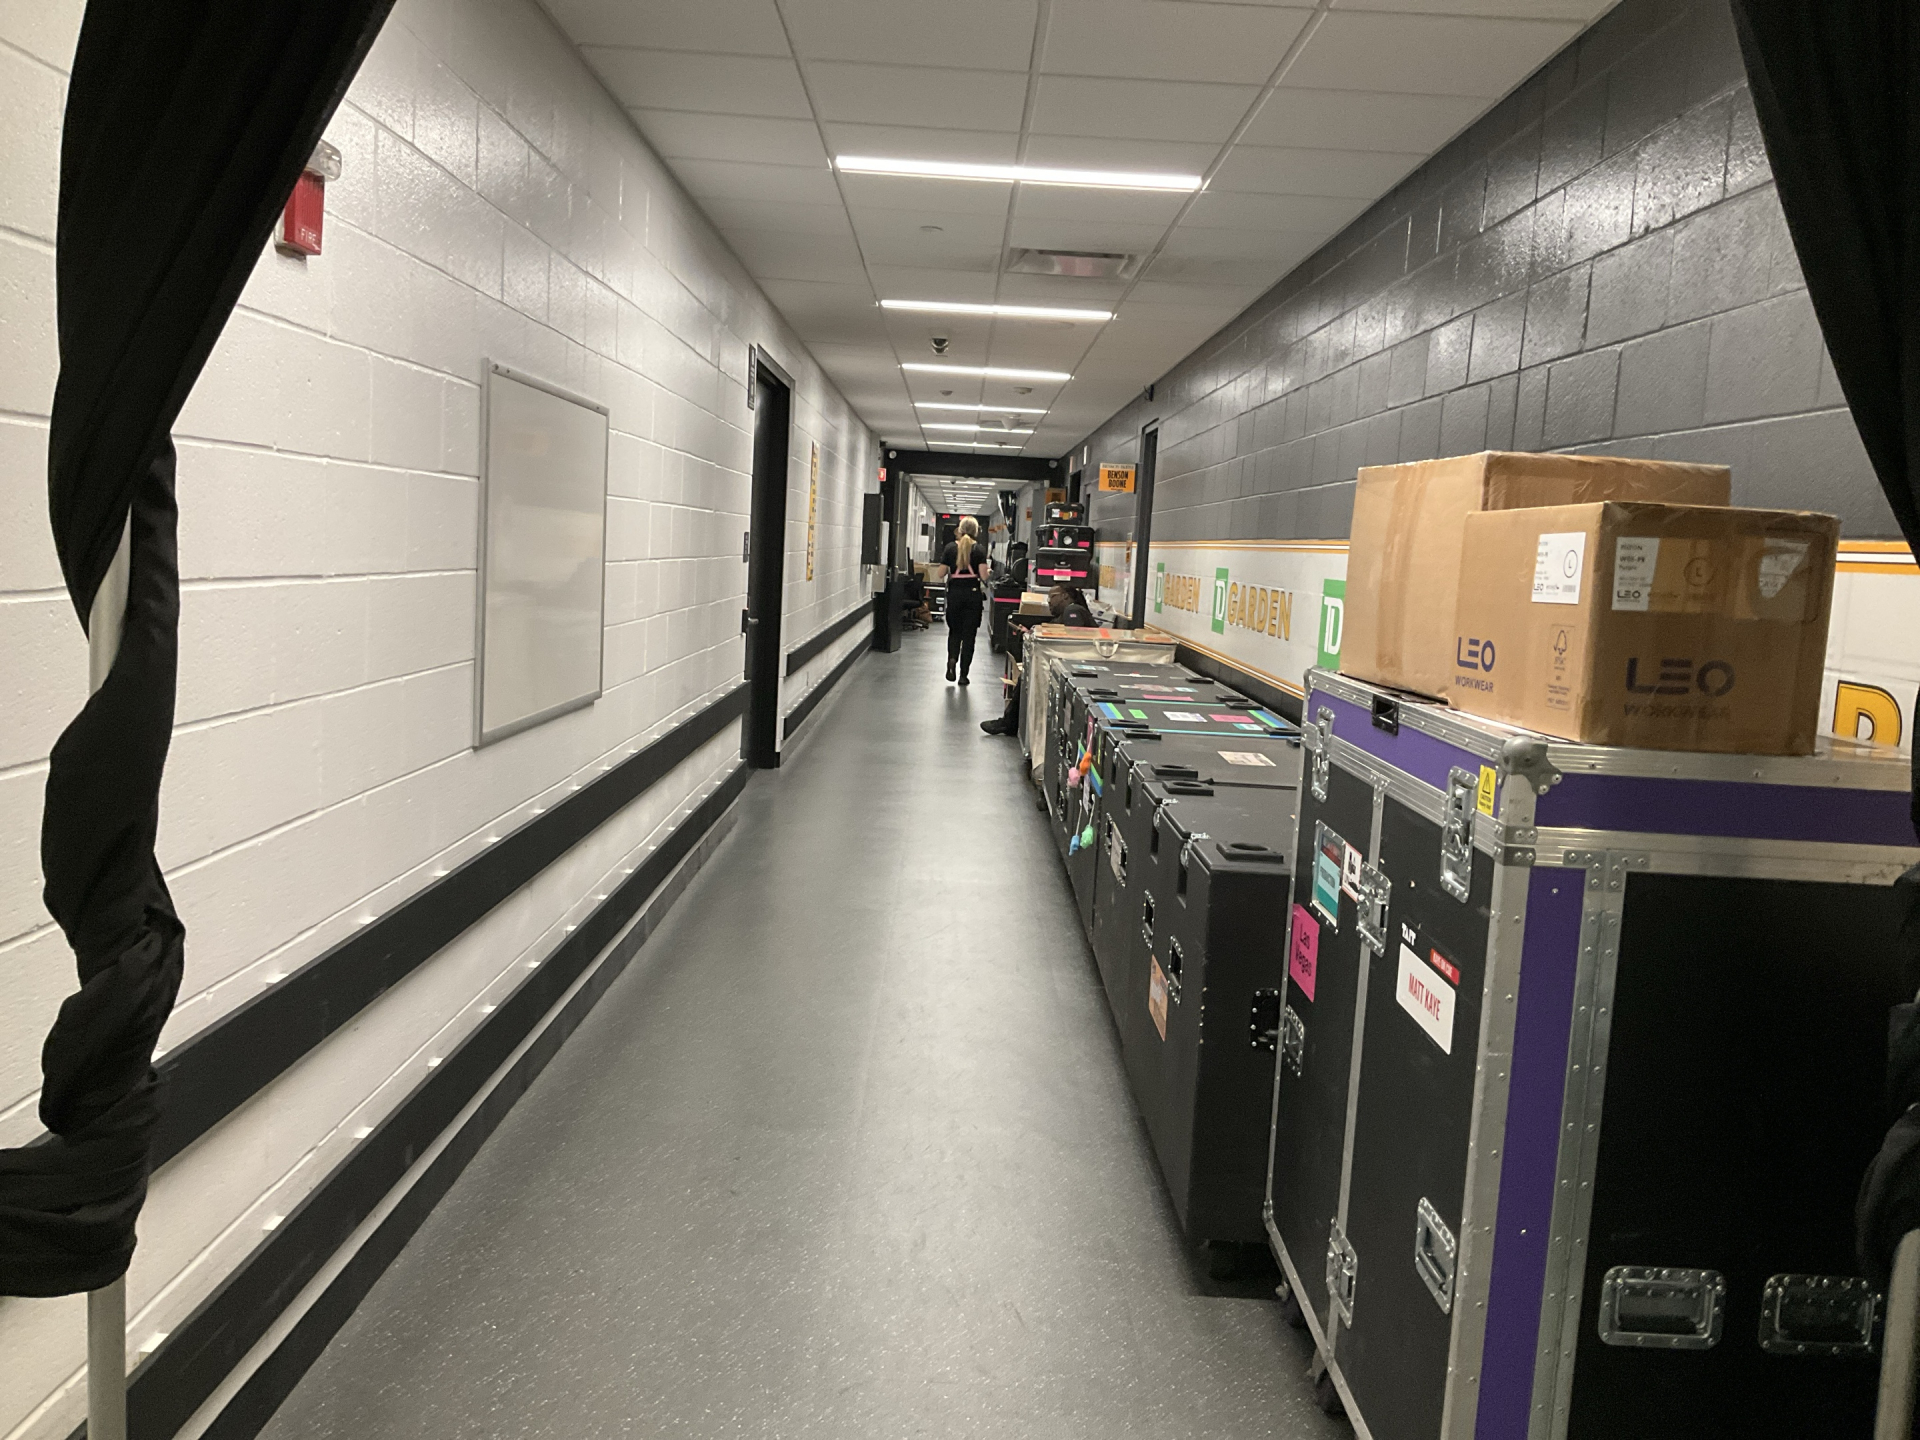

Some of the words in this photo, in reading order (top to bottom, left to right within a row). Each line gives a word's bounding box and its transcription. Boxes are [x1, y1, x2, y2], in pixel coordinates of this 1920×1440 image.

[301, 228, 317, 244] FIRE
[1107, 470, 1129, 480] BENSON
[1108, 479, 1127, 488] BOONE
[1164, 572, 1201, 614] GARDEN
[1617, 590, 1641, 598] LEO
[1227, 582, 1293, 641] GARDEN
[1456, 636, 1496, 673] LEO
[1455, 675, 1494, 693] WORKWEAR
[1625, 658, 1736, 698] LEO
[1299, 924, 1311, 950] Las
[1401, 922, 1417, 947] TAIT
[1295, 941, 1313, 977] Vegas
[1408, 973, 1425, 1005] MATT
[1424, 988, 1441, 1022] KAYE
